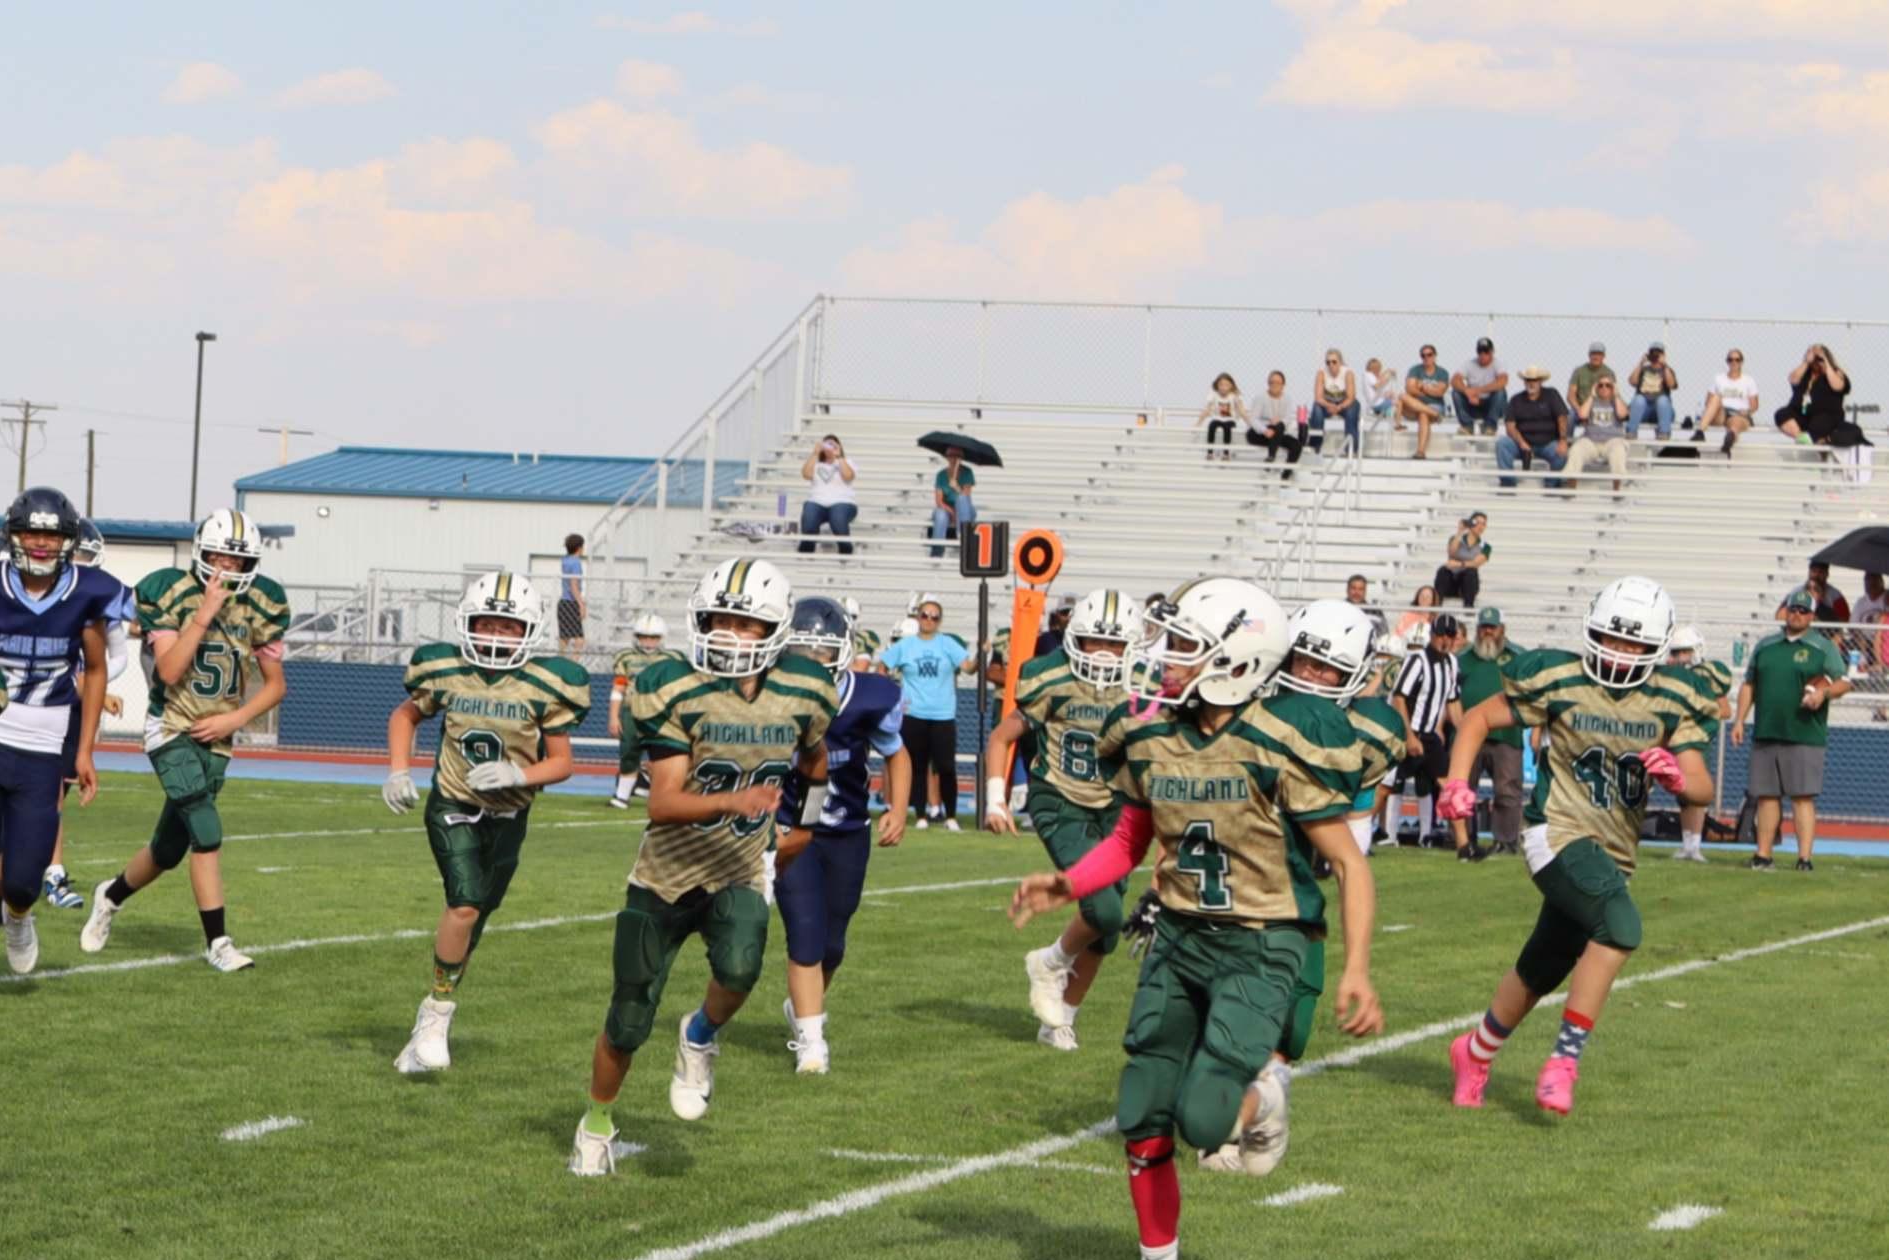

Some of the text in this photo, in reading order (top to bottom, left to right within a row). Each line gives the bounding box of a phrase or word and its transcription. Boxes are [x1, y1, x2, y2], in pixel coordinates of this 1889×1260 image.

[975, 523, 992, 568] 1
[701, 723, 795, 746] HIGHLAND
[1571, 712, 1659, 741] HIGHLAND
[1061, 728, 1100, 781] 8
[1150, 775, 1249, 803] HIGHLAND
[1571, 746, 1649, 811] 40
[1176, 820, 1233, 911] 4
